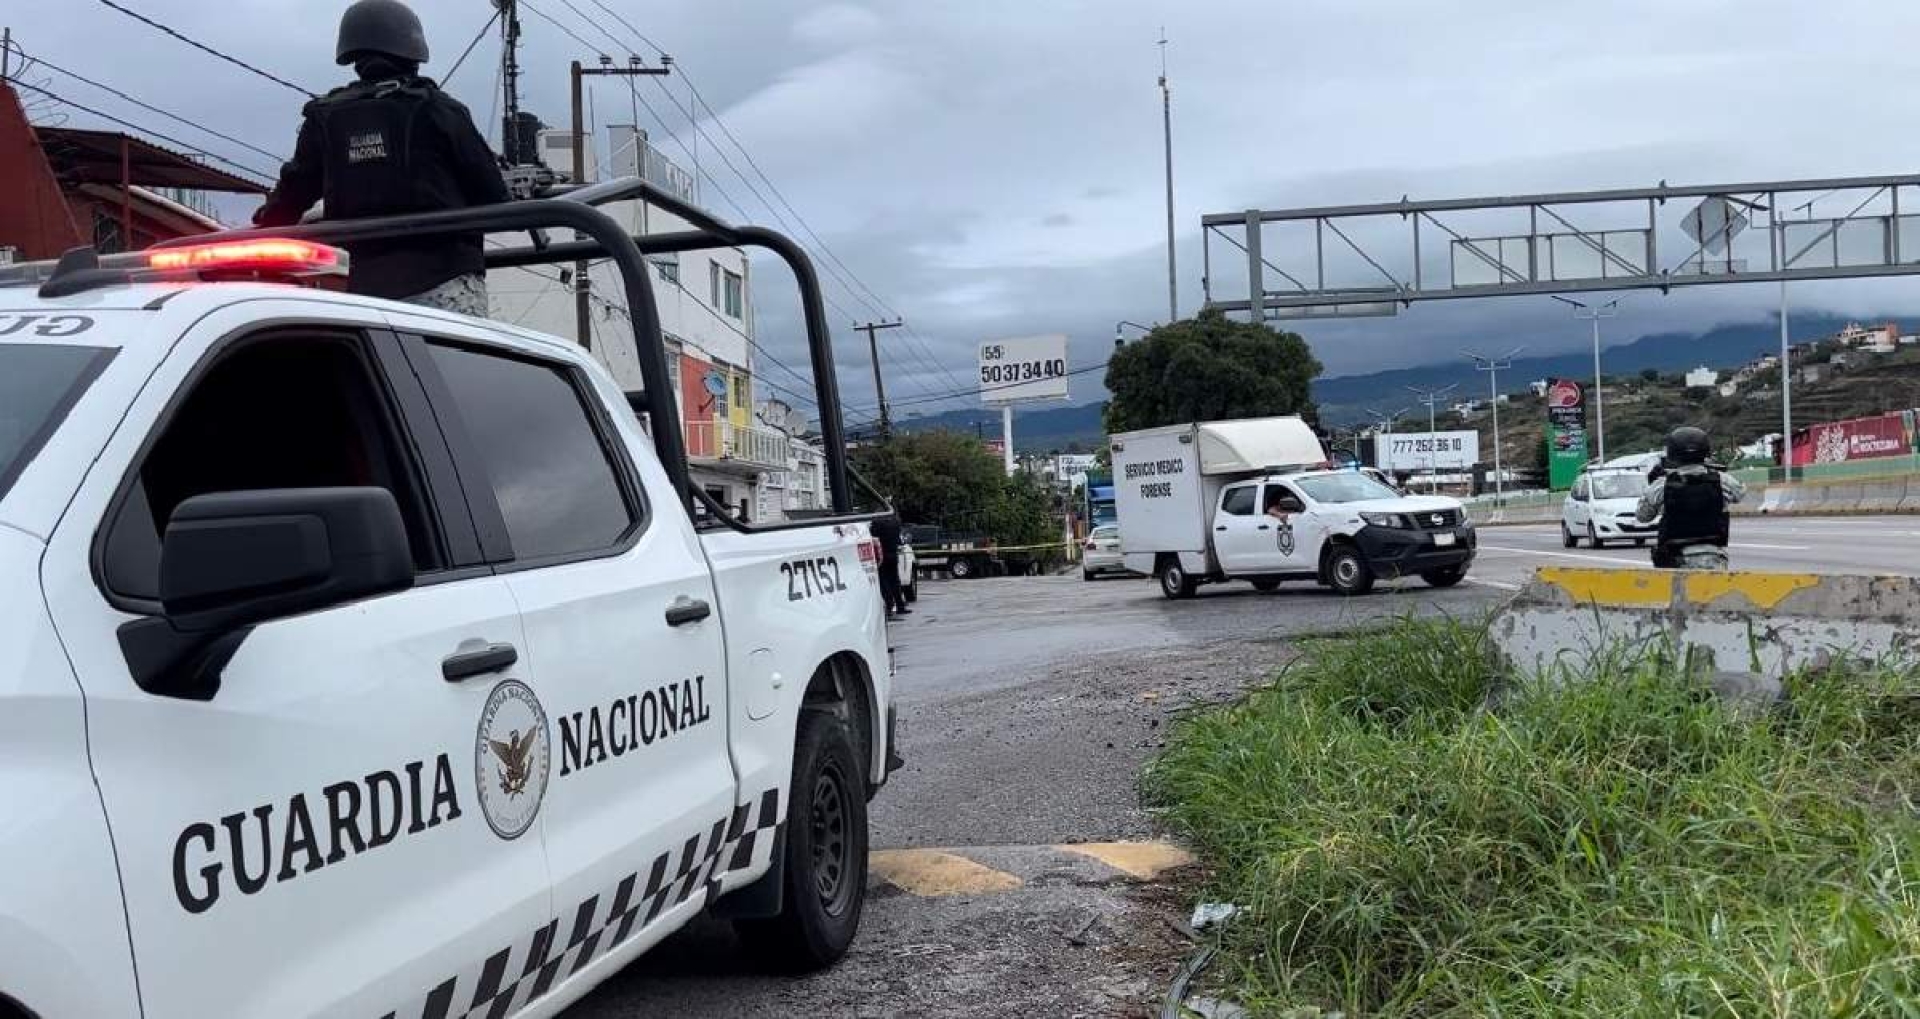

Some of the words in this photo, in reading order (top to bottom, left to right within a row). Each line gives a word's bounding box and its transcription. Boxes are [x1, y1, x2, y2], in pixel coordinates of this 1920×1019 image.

[348, 144, 387, 163] NACIONAL
[1392, 439, 1414, 454] 777
[1415, 439, 1434, 452] 262
[1452, 437, 1462, 451] 10
[1125, 461, 1156, 480] SERVICIO
[1156, 458, 1183, 475] MEDICO
[1140, 482, 1172, 499] FORENSE
[780, 555, 847, 602] 27152
[172, 752, 462, 914] GUARDIA
[559, 675, 710, 776] NACIONAL
